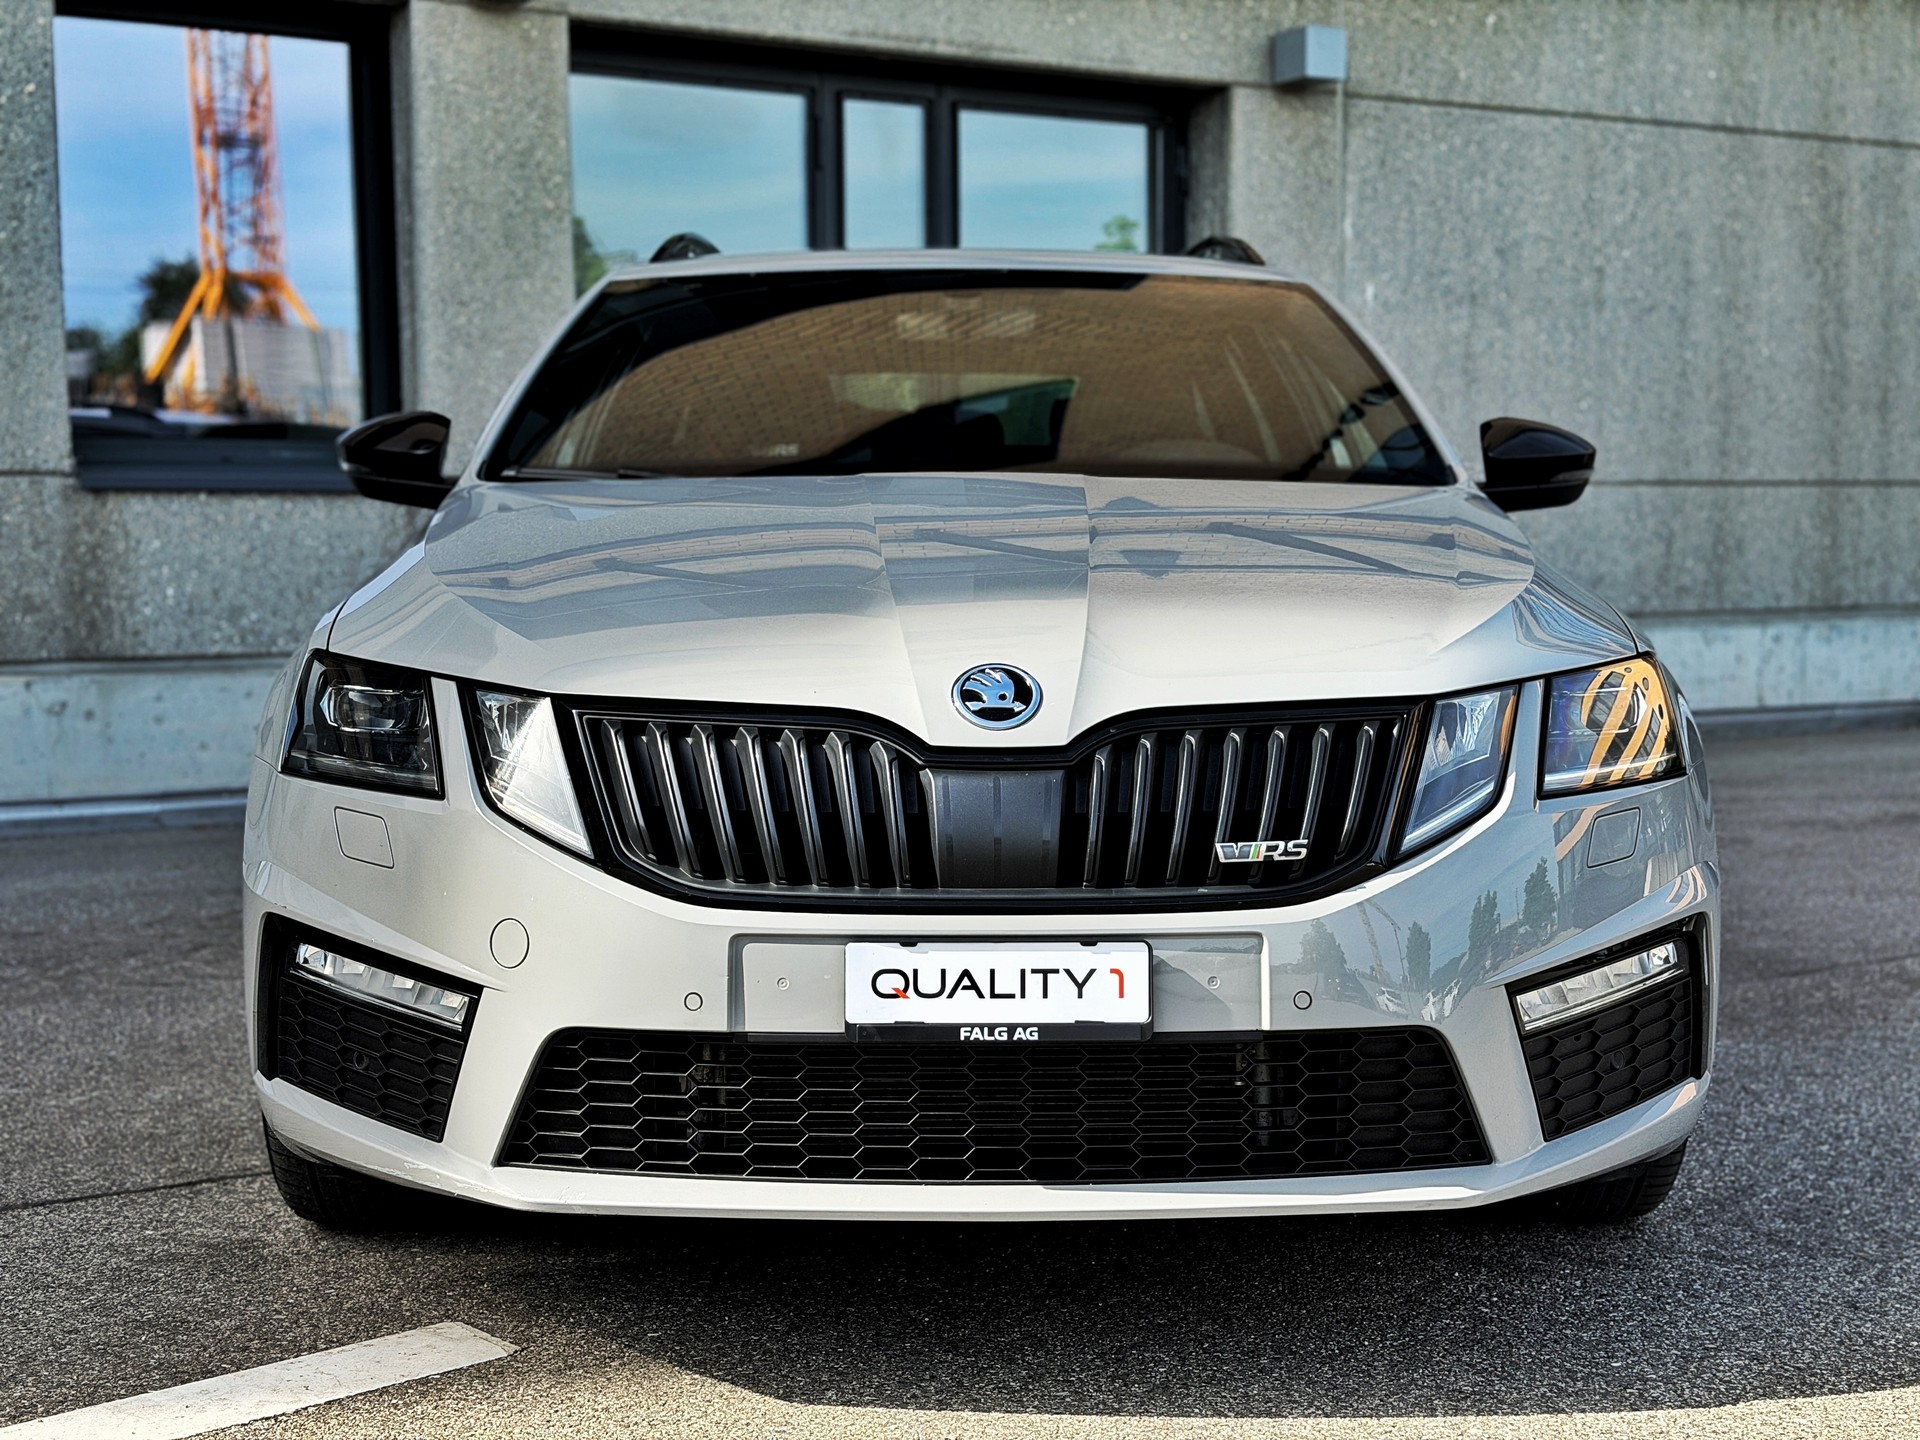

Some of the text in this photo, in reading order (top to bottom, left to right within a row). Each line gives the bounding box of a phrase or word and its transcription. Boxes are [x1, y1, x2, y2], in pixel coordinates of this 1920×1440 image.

[871, 968, 1125, 999] QUALITY 1
[960, 1026, 1039, 1041] FALG AG
